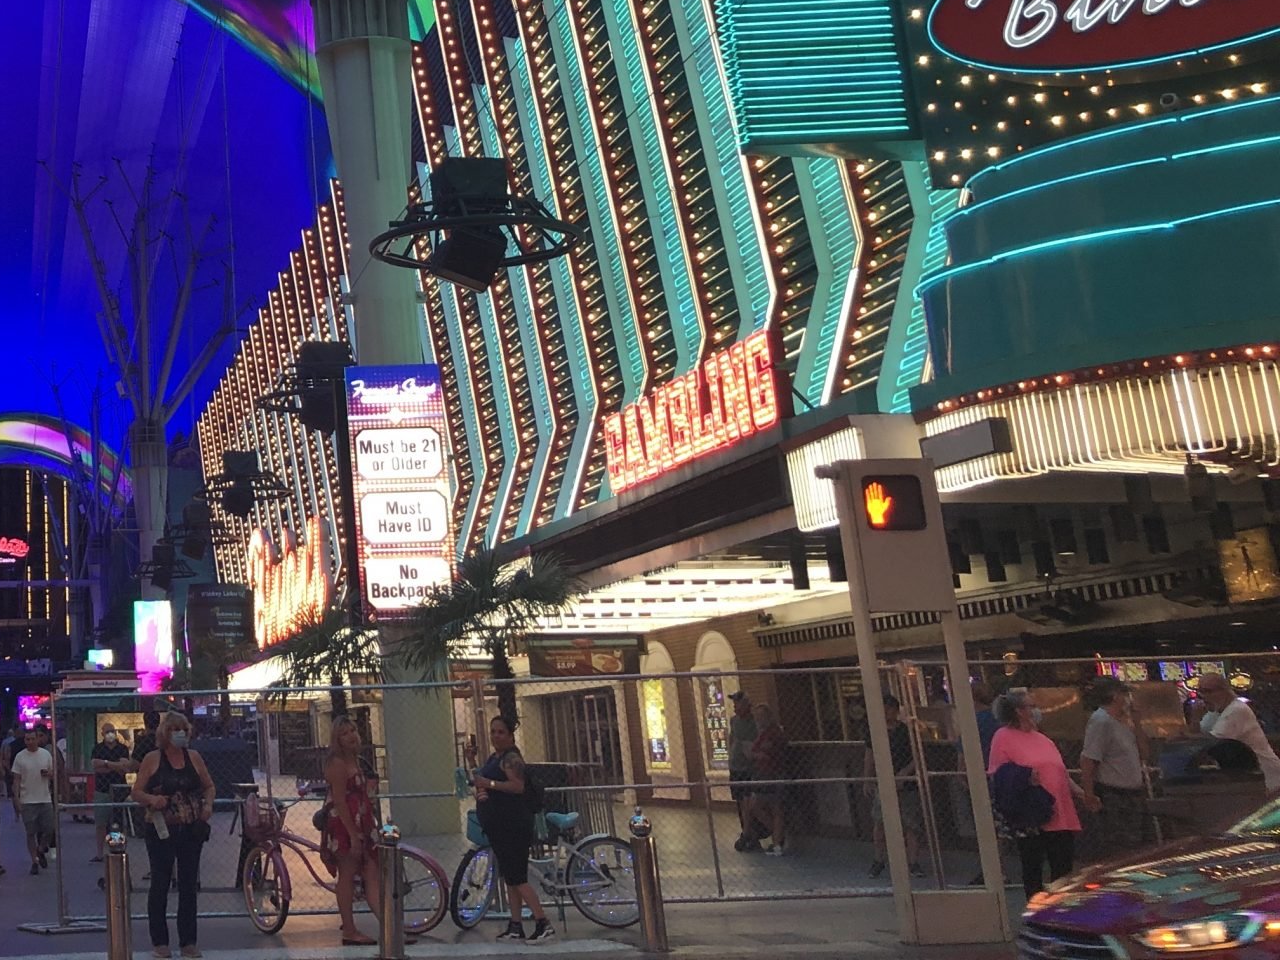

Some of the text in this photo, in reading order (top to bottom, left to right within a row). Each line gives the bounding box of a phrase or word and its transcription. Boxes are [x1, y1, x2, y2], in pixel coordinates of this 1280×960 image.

[604, 328, 778, 496] GAMBLING
[359, 439, 437, 454] Must be 21
[372, 457, 428, 471] or Older
[385, 501, 422, 515] Must
[378, 517, 432, 533] Have ID
[399, 564, 418, 579] No
[371, 581, 449, 600] Backpacks
